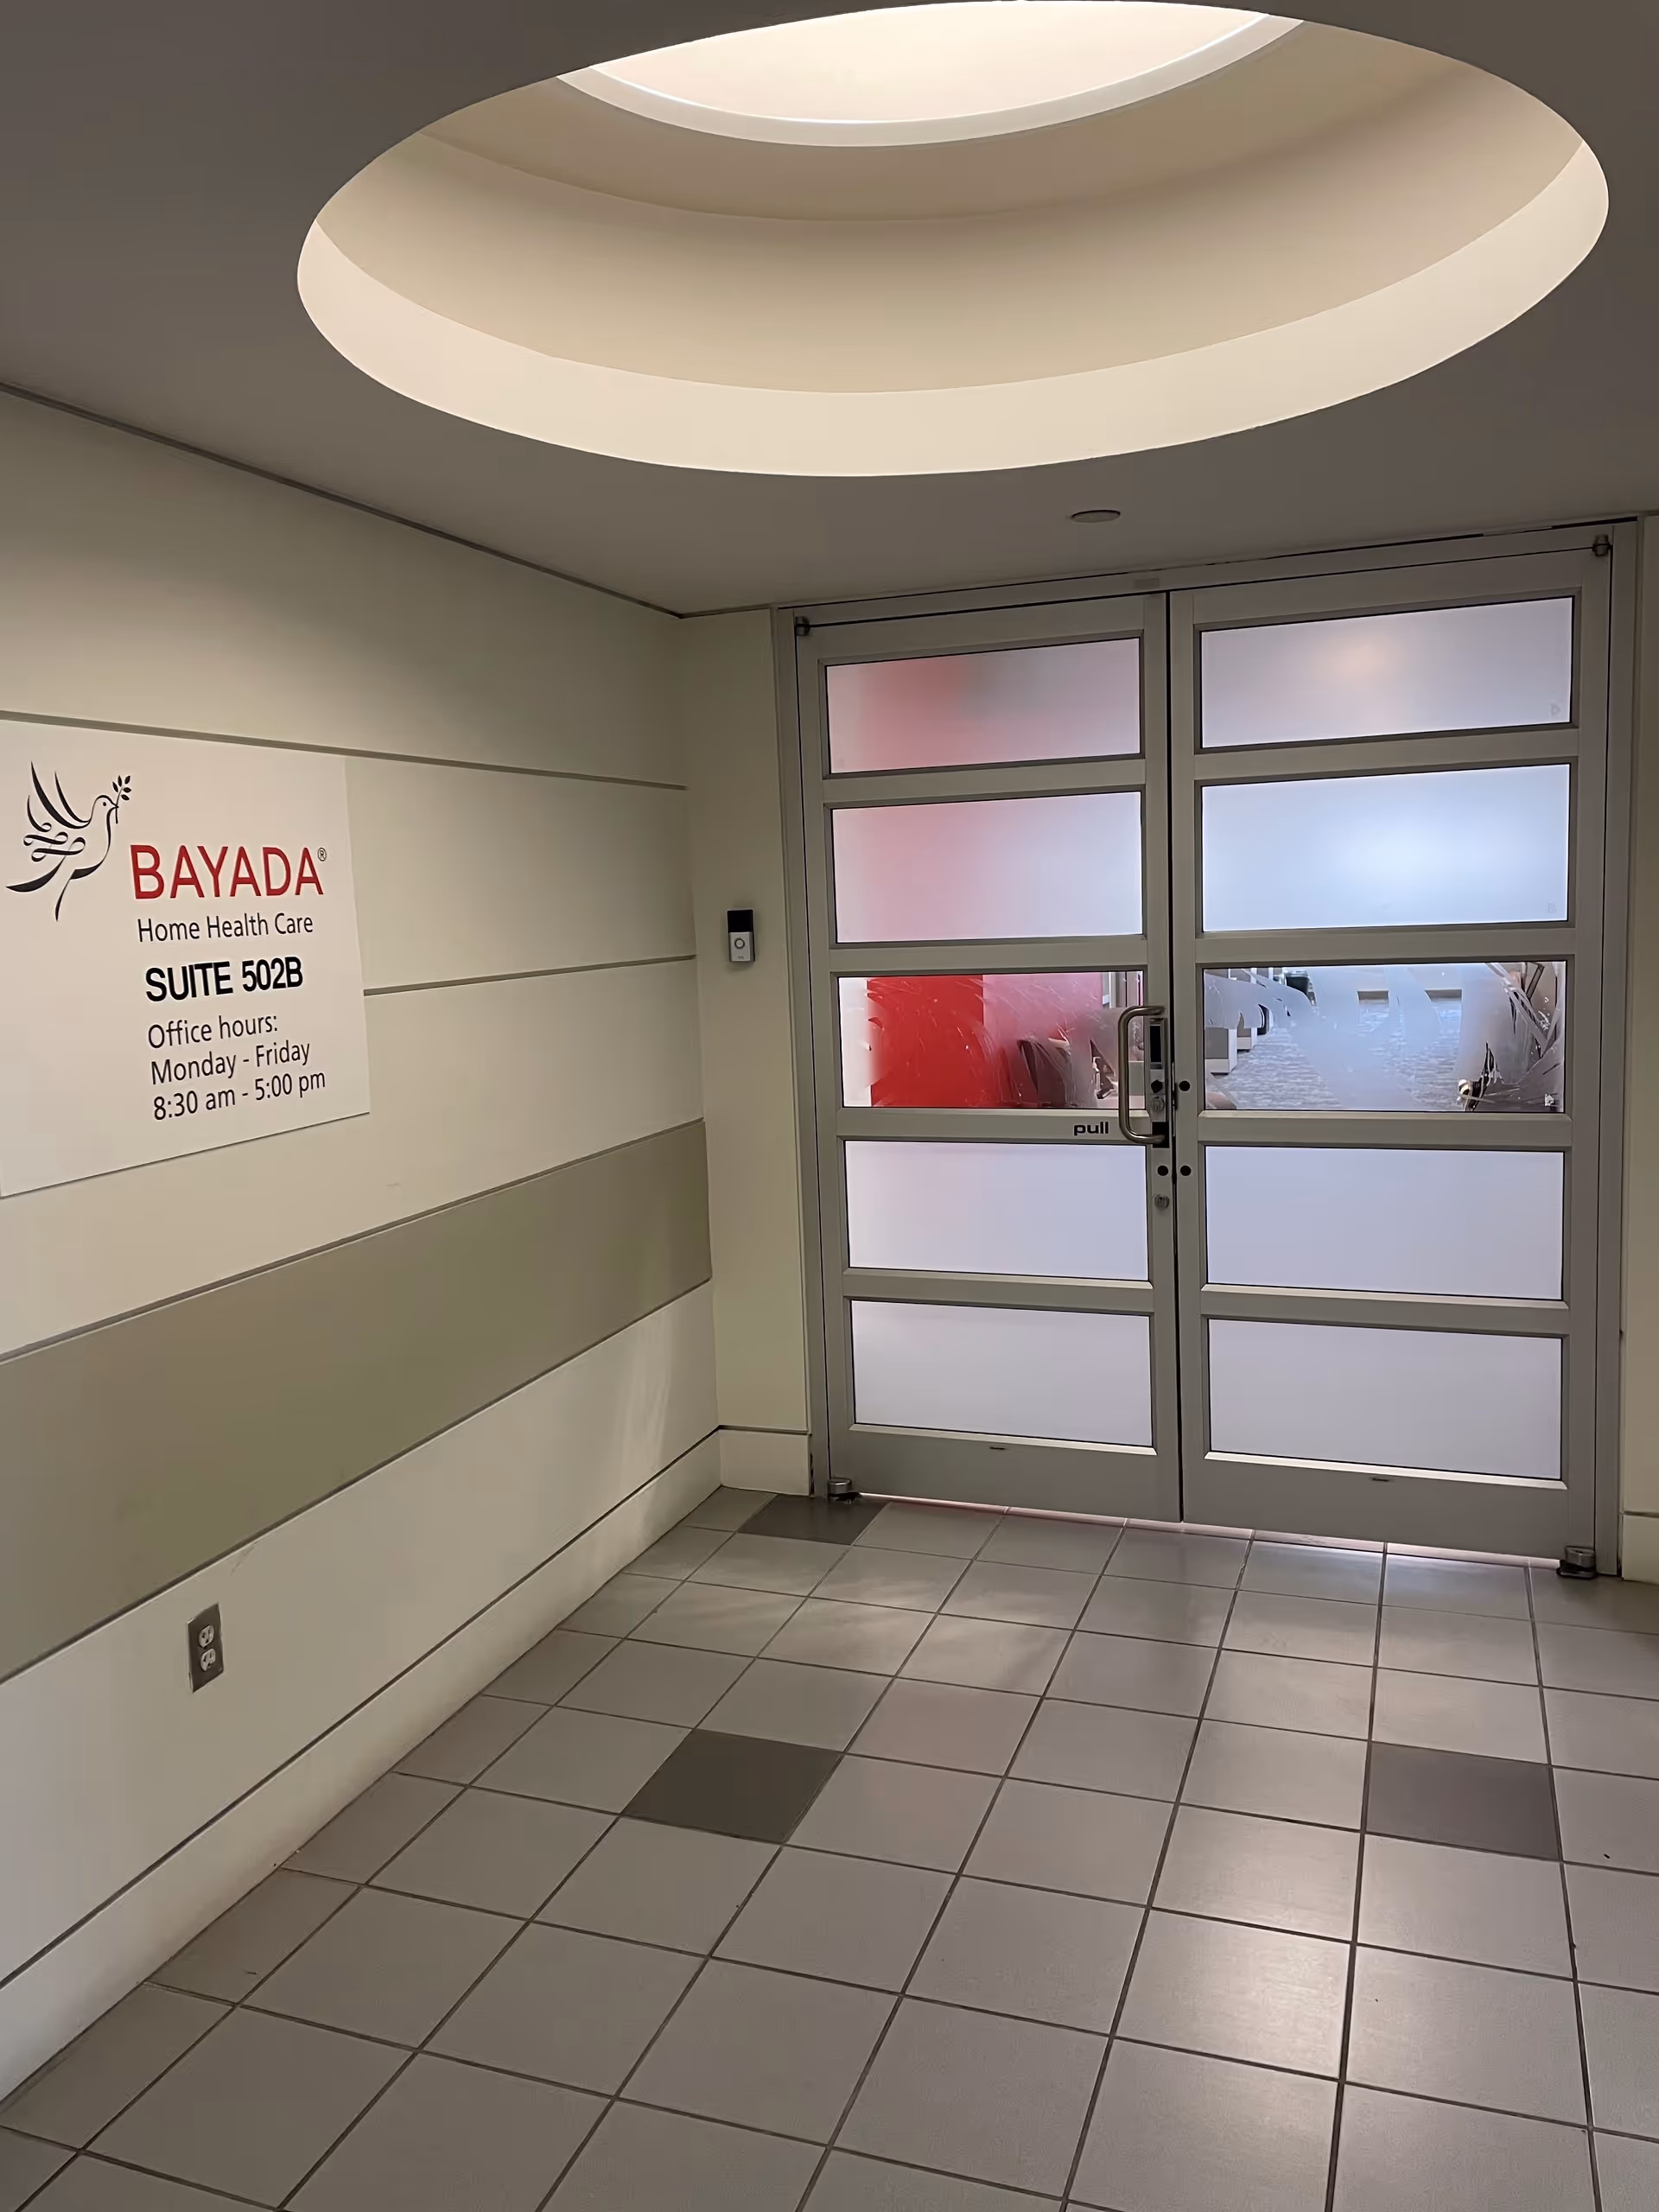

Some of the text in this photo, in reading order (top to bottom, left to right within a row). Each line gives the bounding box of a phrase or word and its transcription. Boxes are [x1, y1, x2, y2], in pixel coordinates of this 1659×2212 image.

[137, 912, 313, 942] Home Health Care
[146, 957, 302, 1001] SUITE 502B
[149, 1014, 277, 1048] Office hours:
[151, 1051, 236, 1084] Monday
[256, 1039, 309, 1067] Friday
[154, 1090, 198, 1120] 8:30
[206, 1090, 235, 1110] am
[255, 1074, 292, 1100] 5:00
[299, 1073, 325, 1098] pm
[1074, 1122, 1109, 1136] pull
